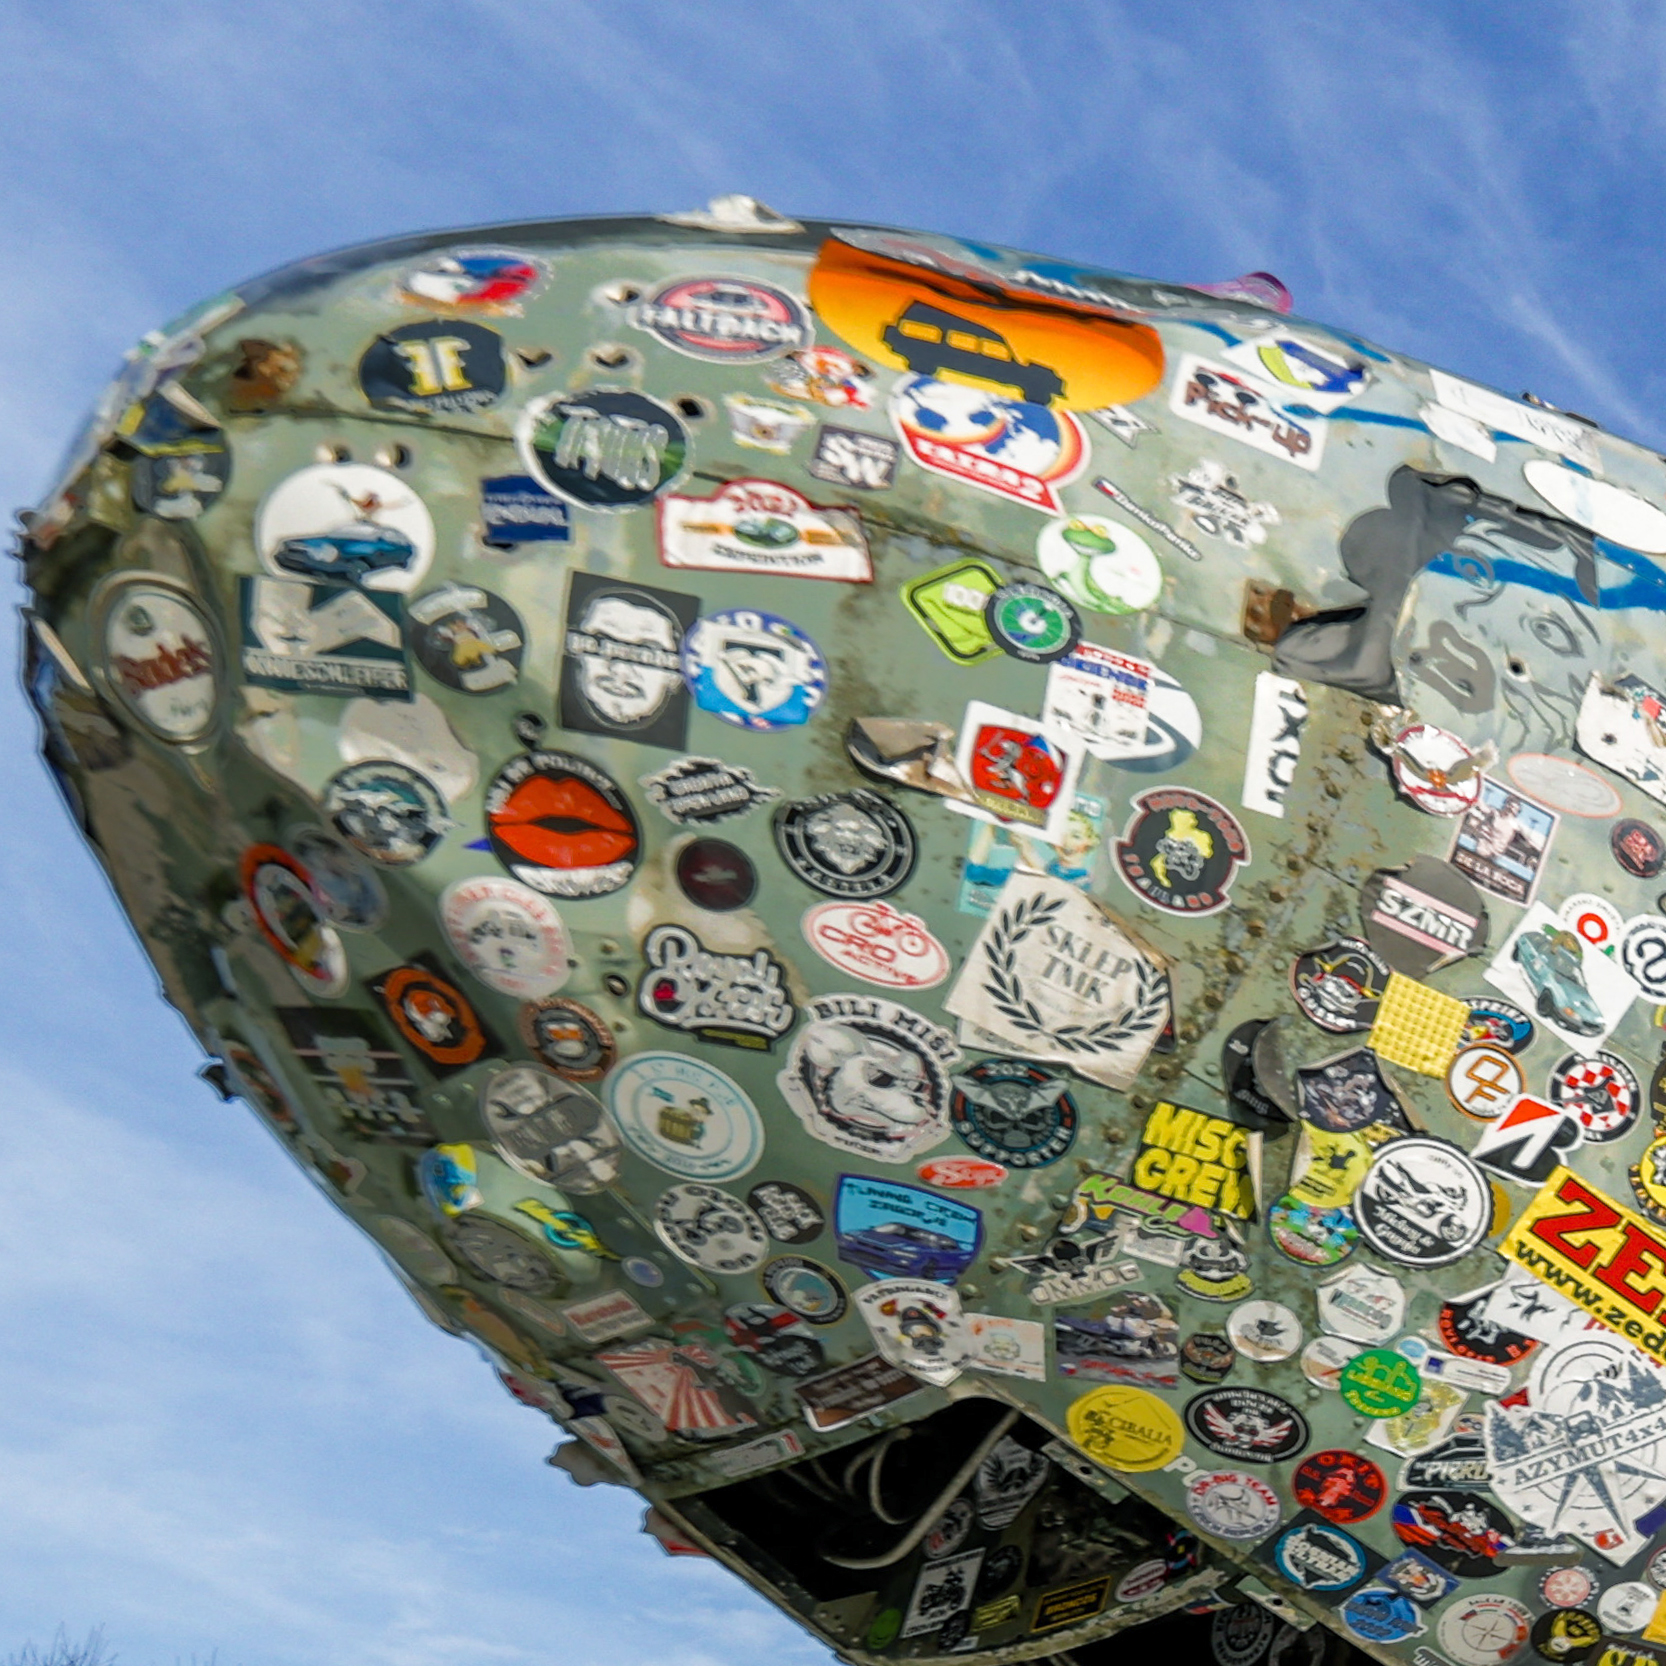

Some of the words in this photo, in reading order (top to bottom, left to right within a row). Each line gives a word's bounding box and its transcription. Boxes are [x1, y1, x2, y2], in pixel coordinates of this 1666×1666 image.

[1376, 889, 1472, 947] SZMR
[959, 1121, 1073, 1167] SUPPORTER
[1512, 1438, 1627, 1488] AZYMUT
